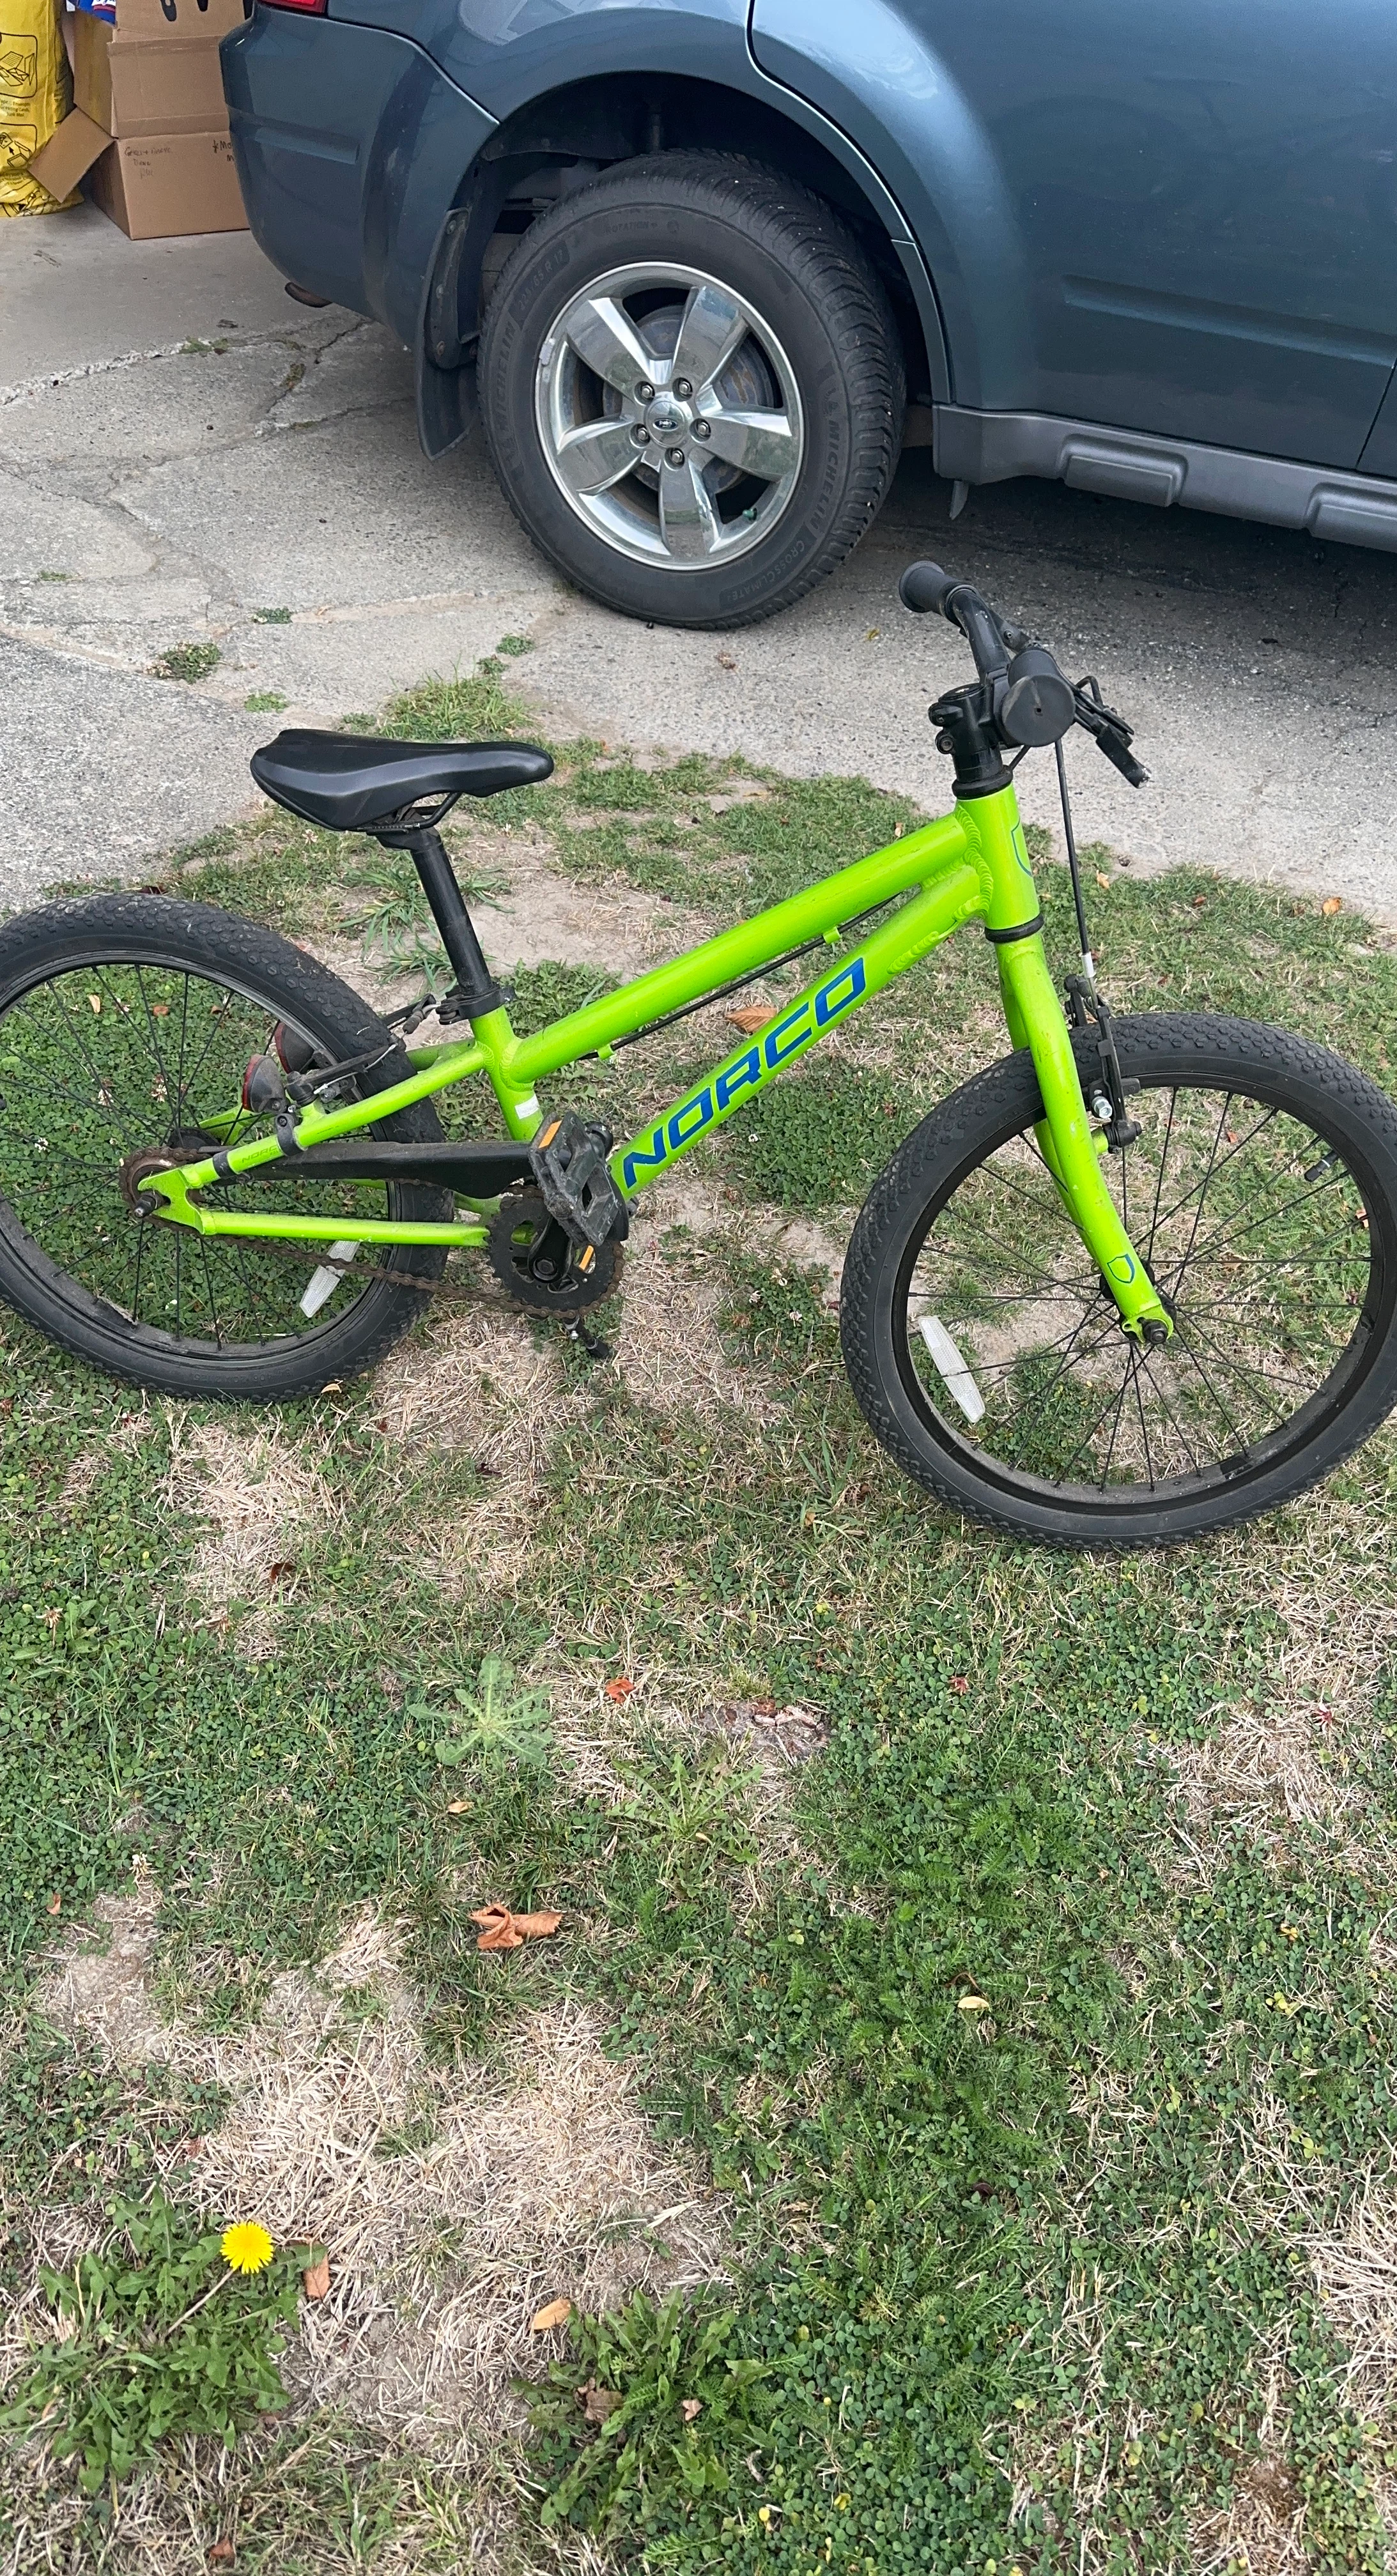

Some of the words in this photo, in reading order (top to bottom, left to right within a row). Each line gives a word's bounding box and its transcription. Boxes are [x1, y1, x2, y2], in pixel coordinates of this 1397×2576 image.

[495, 321, 517, 433] MICHELIN
[810, 420, 840, 530] MICHELIN
[623, 956, 866, 1189] NORCO
